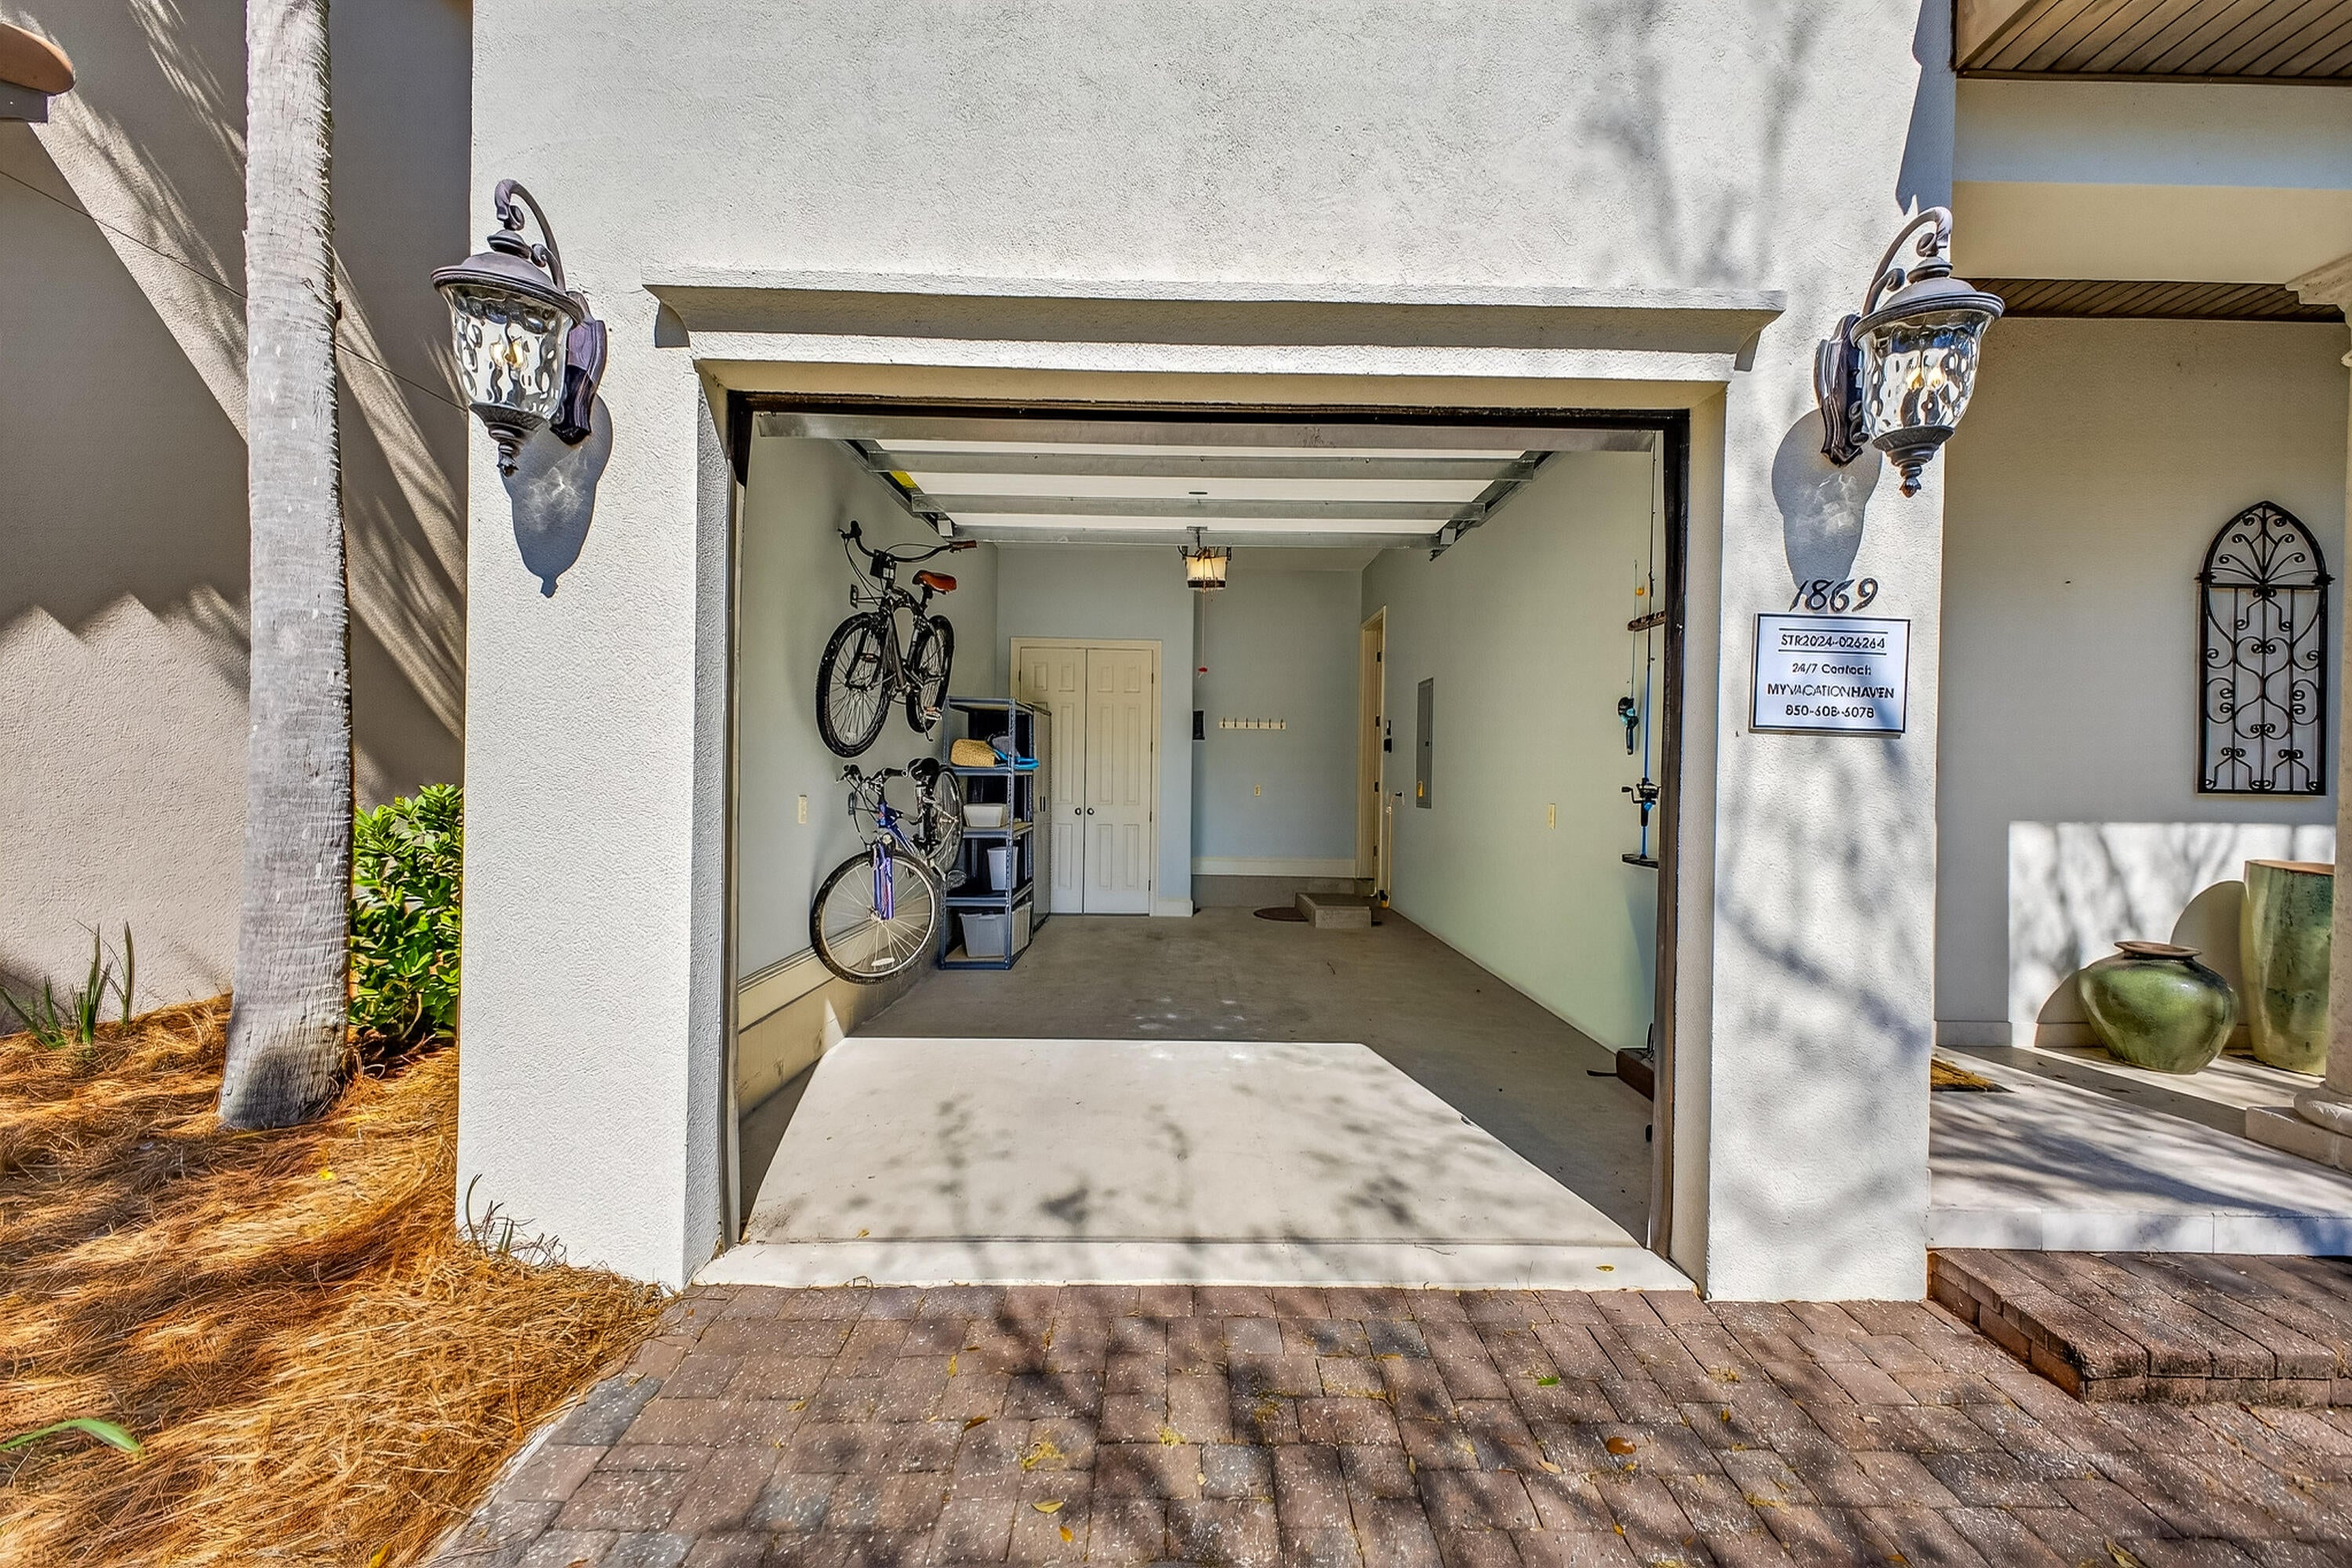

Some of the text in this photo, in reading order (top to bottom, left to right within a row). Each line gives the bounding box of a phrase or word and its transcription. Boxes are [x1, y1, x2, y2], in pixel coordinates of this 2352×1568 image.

[1788, 577, 1878, 612] 1869
[1792, 662, 1818, 674] 24/7
[1767, 683, 1895, 699] MYVACATIONHAVEN
